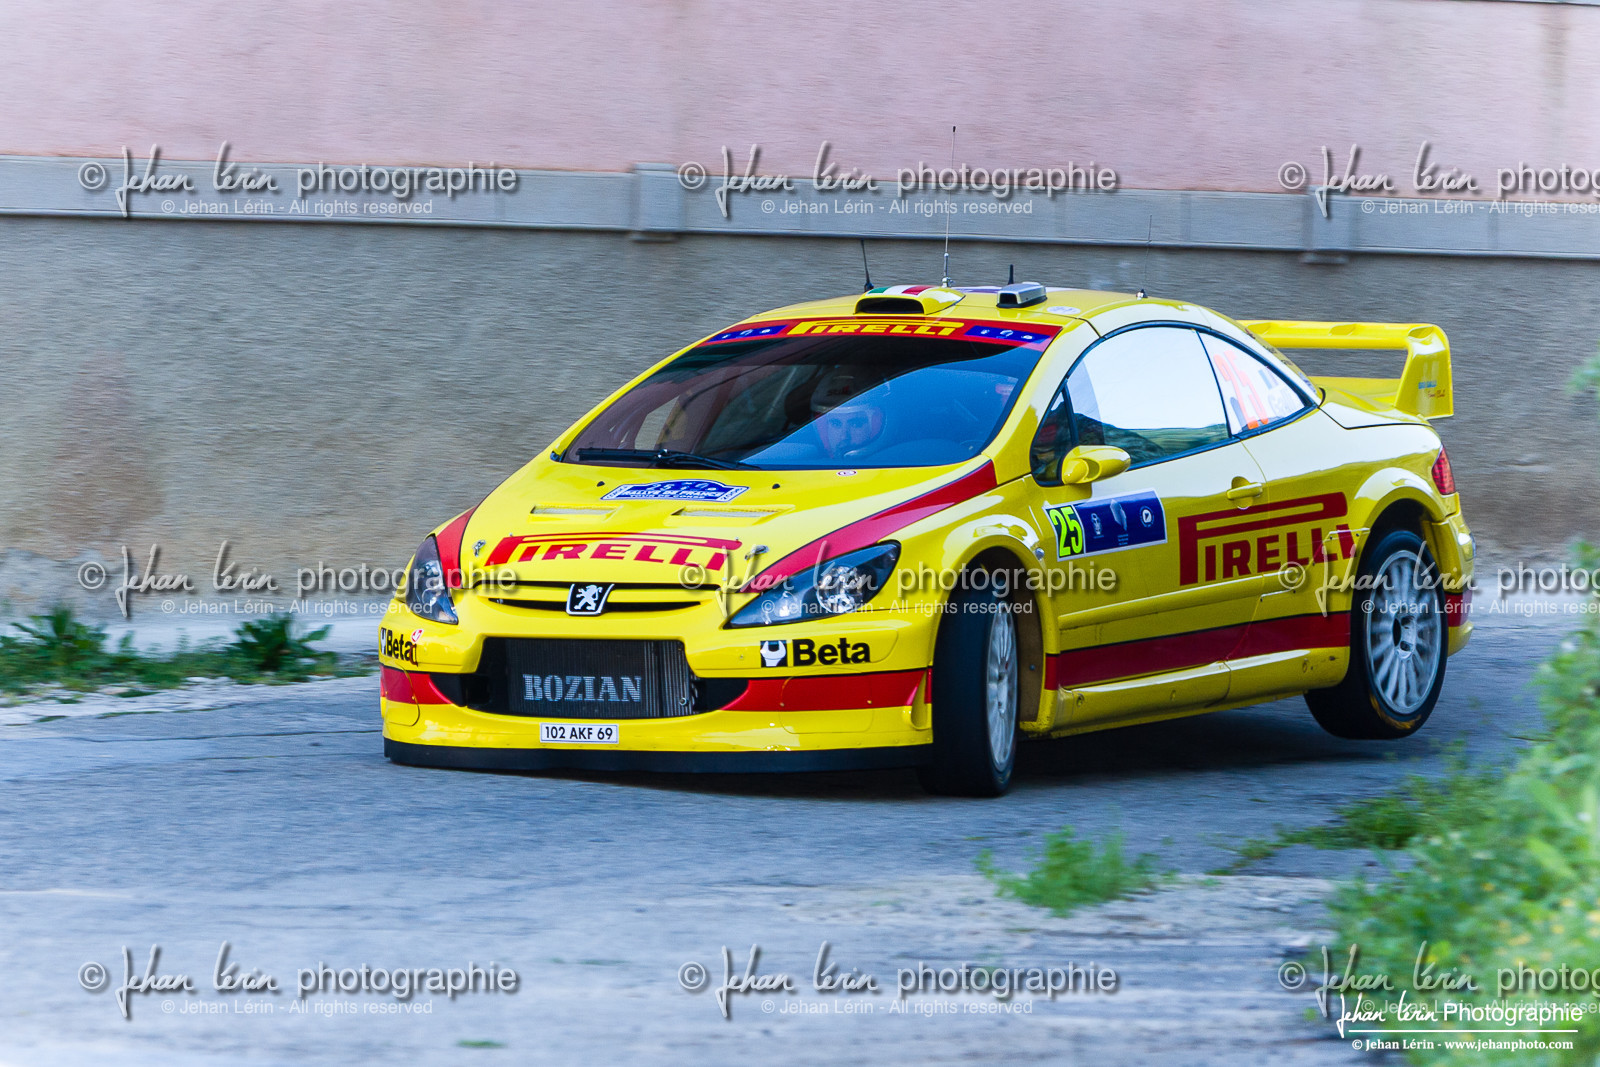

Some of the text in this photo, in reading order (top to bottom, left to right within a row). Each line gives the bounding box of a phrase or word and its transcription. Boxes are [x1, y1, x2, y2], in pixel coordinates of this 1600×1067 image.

[787, 320, 965, 336] PIRELLI
[1049, 506, 1083, 557] 25
[1177, 491, 1357, 586] PIRELLI
[484, 532, 742, 571] PIRELLI
[387, 629, 413, 662] Beta
[792, 638, 870, 667] Beta
[522, 674, 642, 702] BOZIAN
[545, 726, 613, 740] 102 AKF 69
